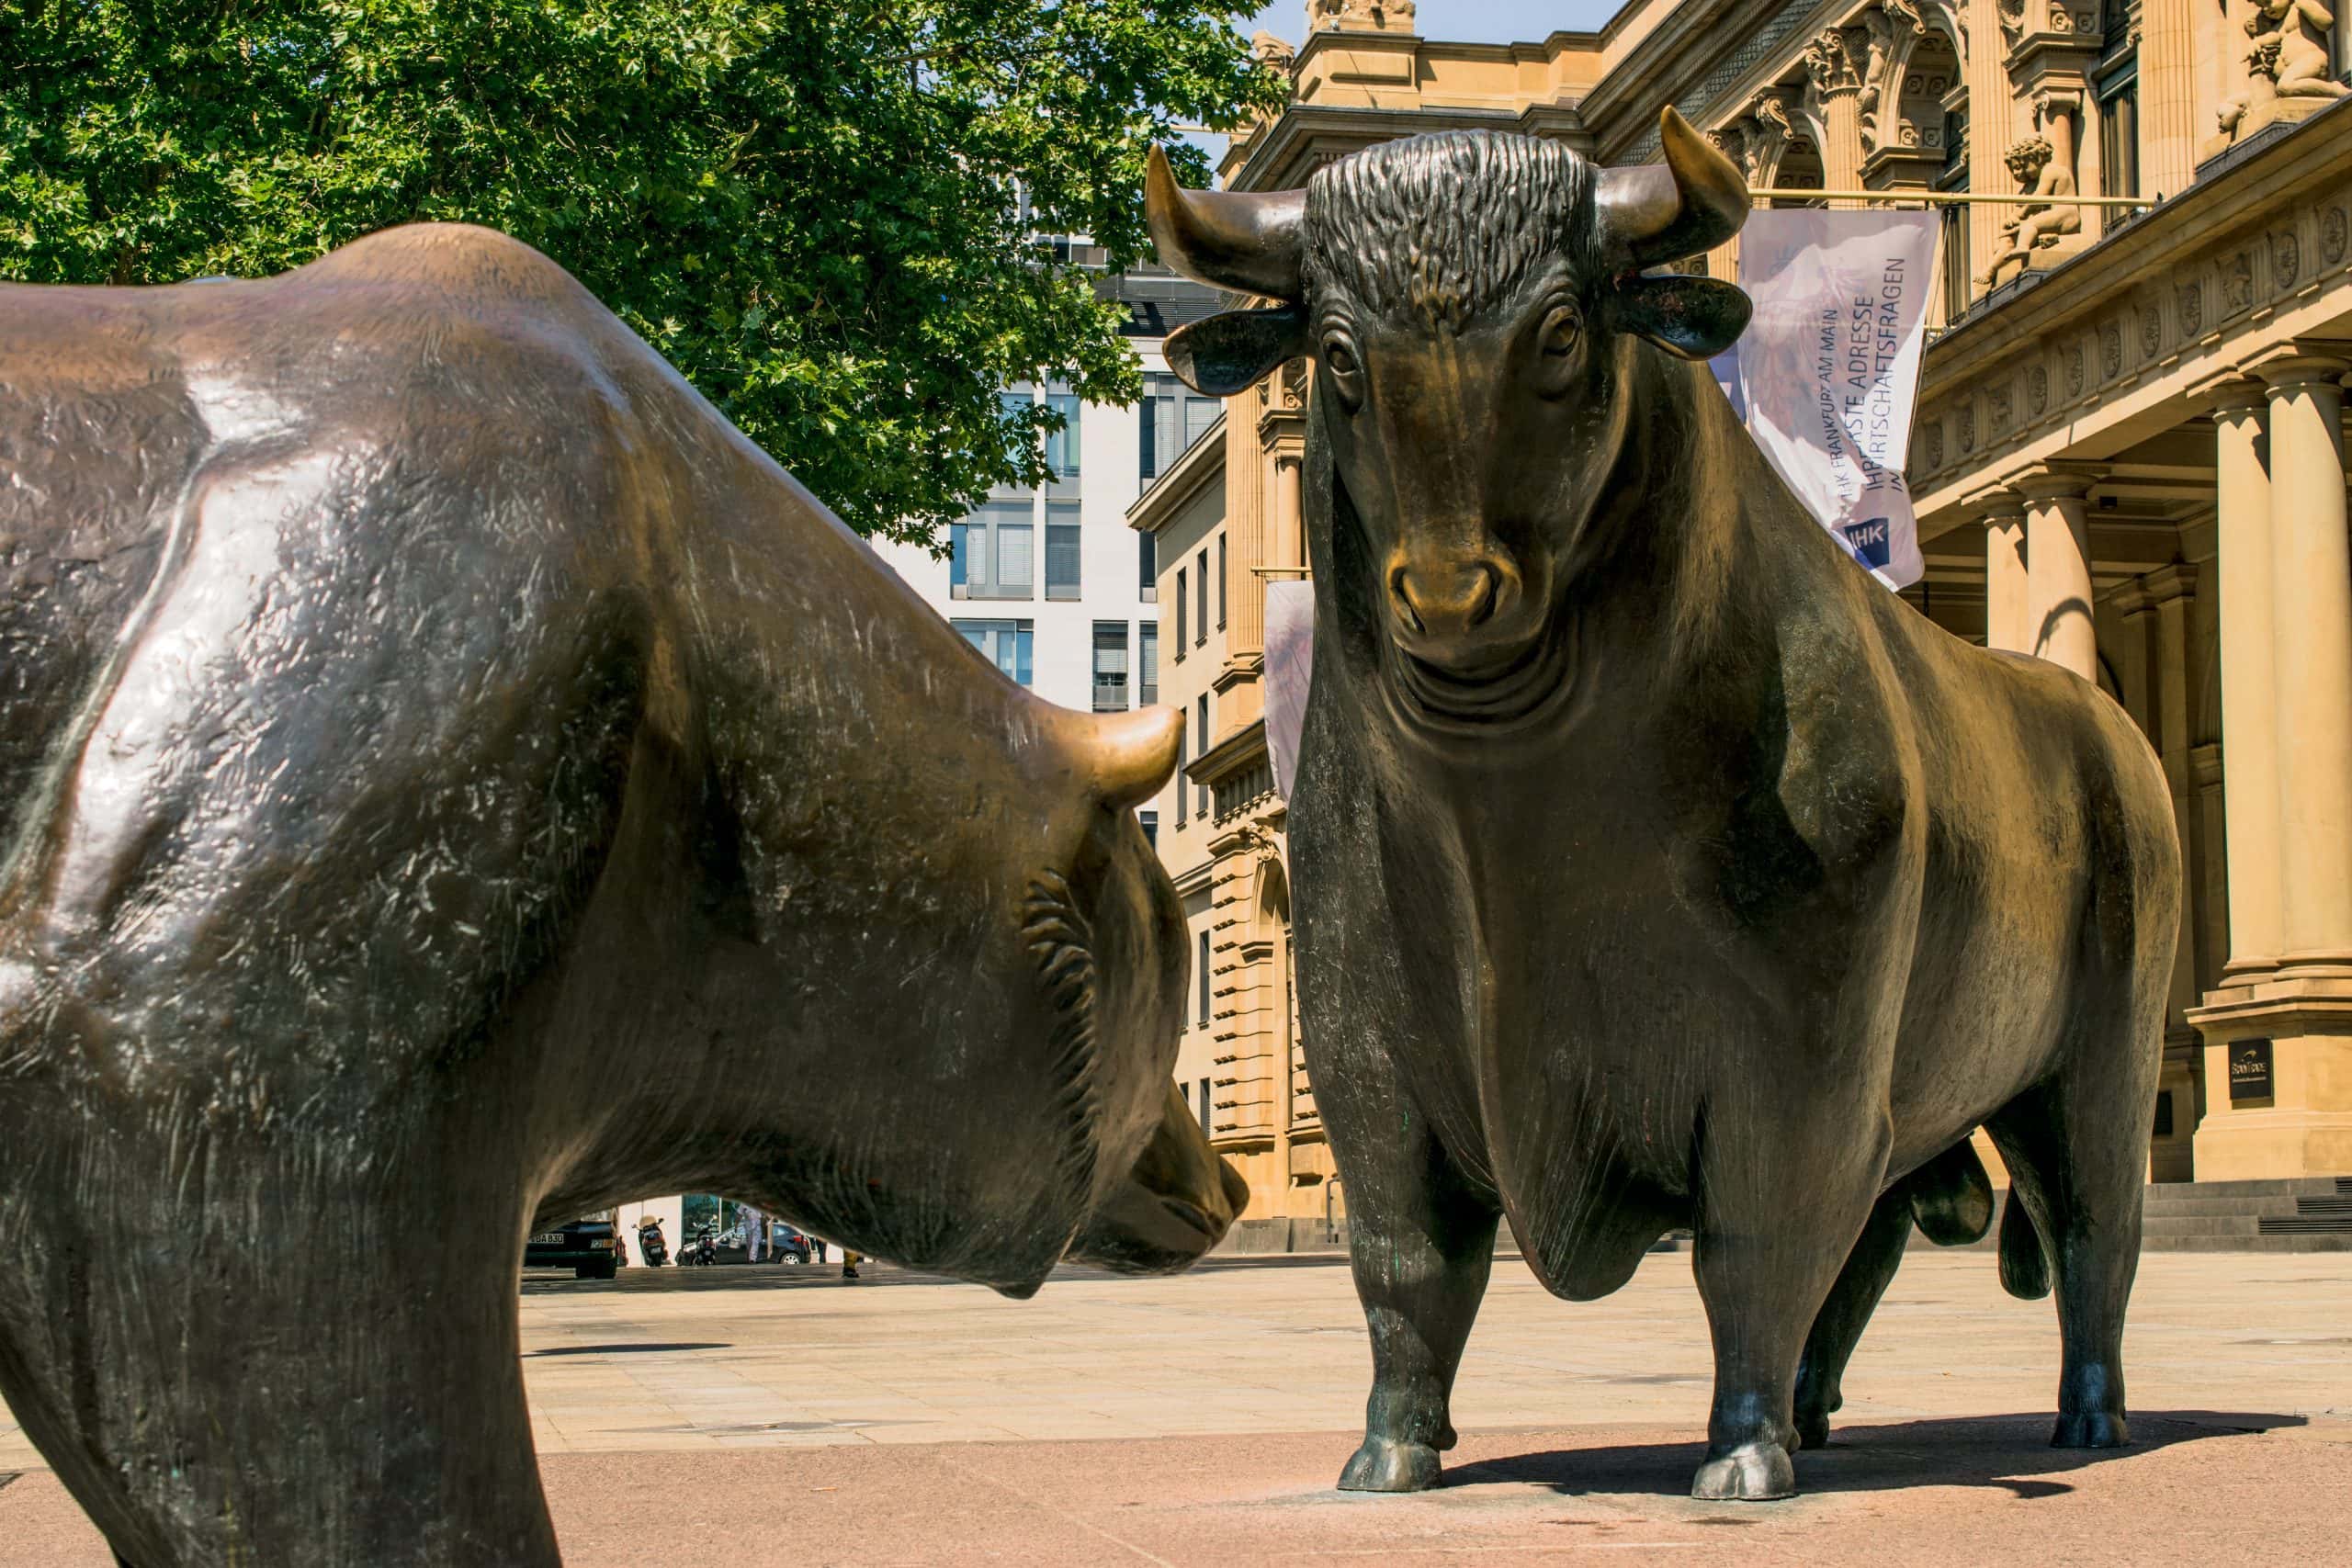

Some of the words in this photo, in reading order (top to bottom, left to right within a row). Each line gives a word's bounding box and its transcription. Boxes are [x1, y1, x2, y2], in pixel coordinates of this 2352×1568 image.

[1819, 310, 1838, 351] MAIN
[1848, 296, 1874, 389] ADRESSE
[1817, 356, 1834, 383] AM
[1868, 258, 1905, 467] IRTSCHAFTSFRAGEN
[1819, 384, 1846, 468] FRANKFURT
[1889, 471, 1904, 492] IN
[1849, 525, 1884, 549] IHK
